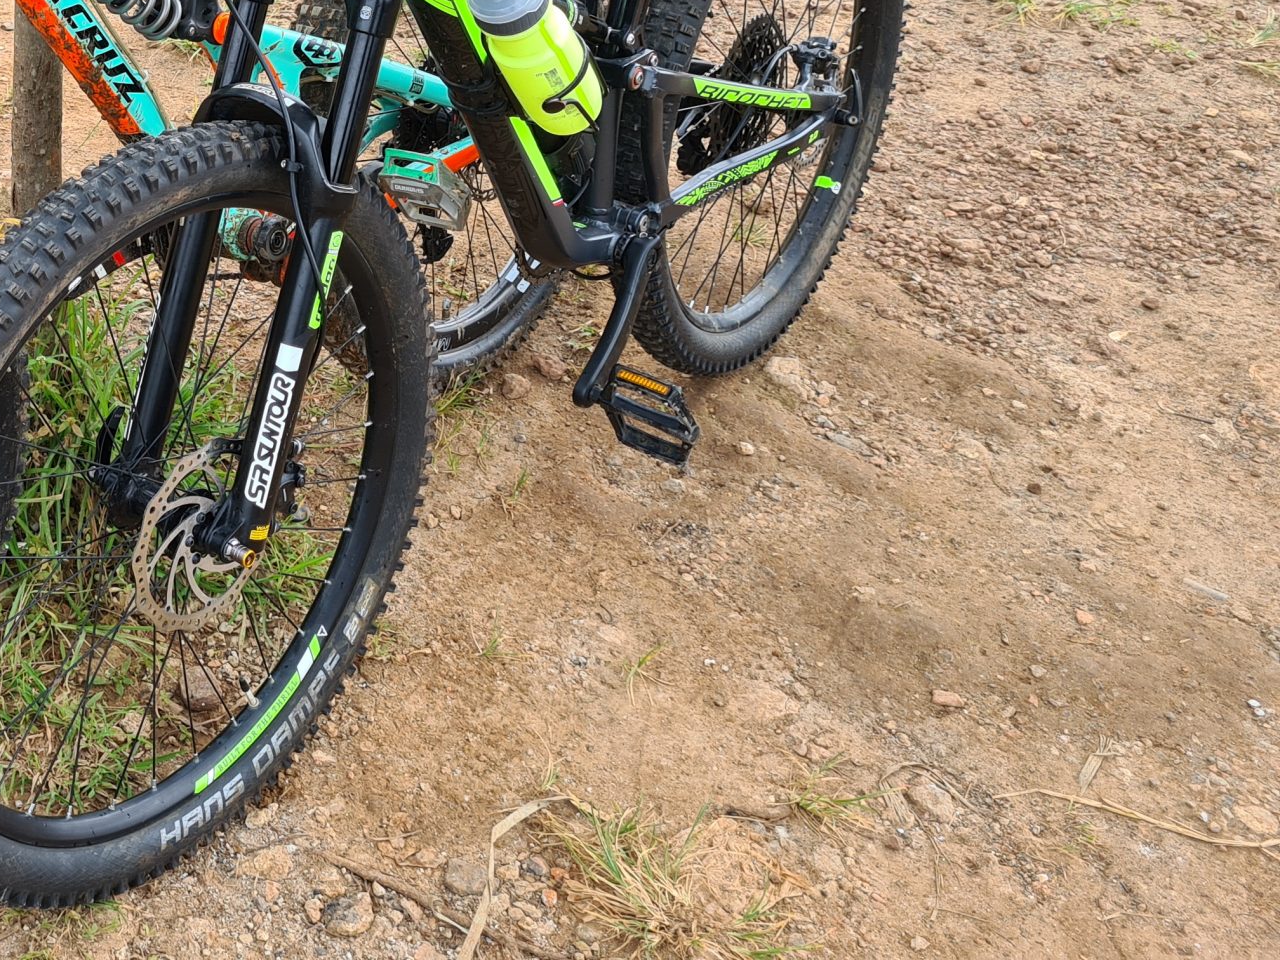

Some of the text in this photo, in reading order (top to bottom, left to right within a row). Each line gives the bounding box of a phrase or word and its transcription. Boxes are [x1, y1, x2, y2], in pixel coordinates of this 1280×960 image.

[60, 2, 146, 104] CRUZ
[698, 84, 808, 108] RICOCHET
[254, 376, 293, 464] SUNTOUR
[216, 678, 299, 773] BUILT FOR THE THRILL
[159, 773, 245, 852] HANS
